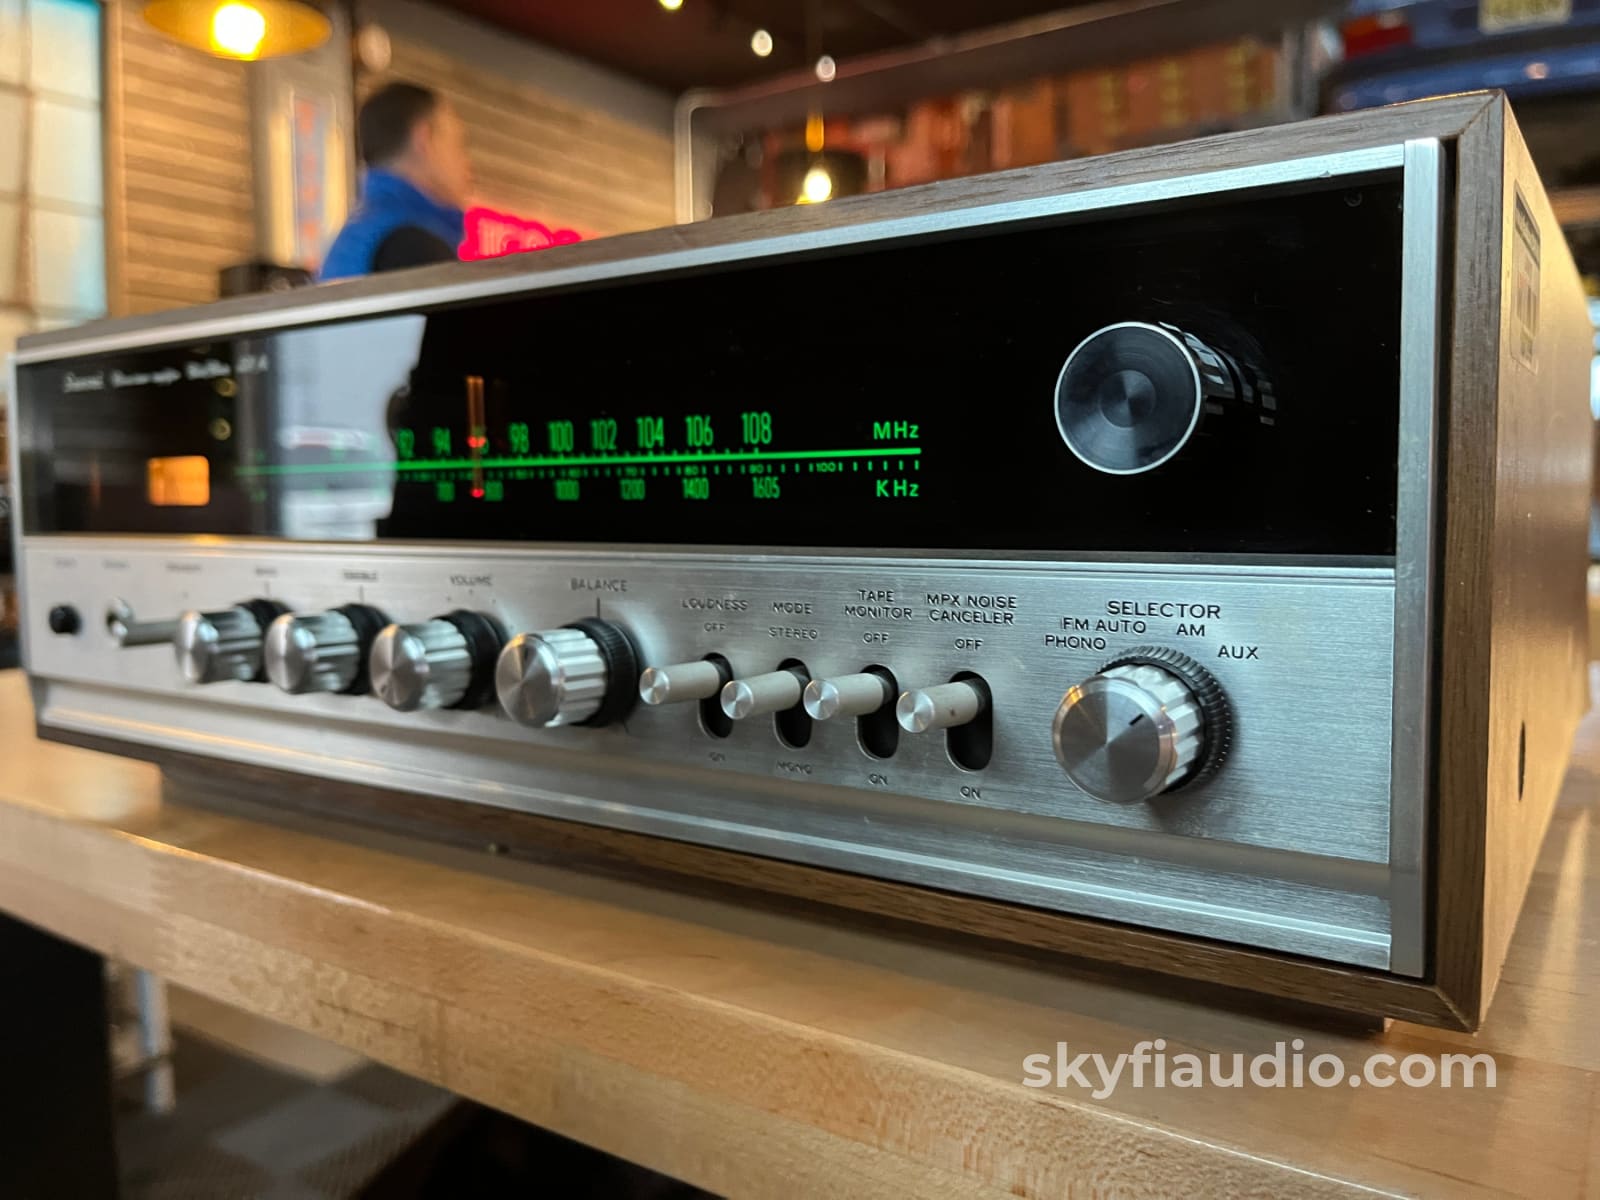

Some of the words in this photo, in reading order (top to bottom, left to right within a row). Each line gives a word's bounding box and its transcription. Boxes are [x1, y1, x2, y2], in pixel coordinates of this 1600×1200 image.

[509, 422, 529, 453] 98
[547, 420, 574, 451] 100
[590, 417, 617, 449] 102
[636, 416, 665, 448] 104
[685, 415, 714, 447] 106
[741, 411, 772, 444] 108
[873, 421, 920, 439] MHz
[752, 476, 780, 498] 1605
[571, 577, 628, 592] BALANCE
[858, 589, 894, 602] TAPE
[927, 594, 959, 607] MPX
[967, 595, 1017, 609] NOISE
[682, 598, 749, 611] LOUDNESS
[773, 602, 812, 614] MODE
[1107, 600, 1221, 619] SELECTOR
[845, 605, 912, 618] MONITOR
[929, 609, 1014, 625] CANCELER
[704, 623, 725, 632] OFF
[1062, 617, 1089, 630] FM
[1096, 619, 1146, 634] AUTO
[1176, 623, 1205, 636] AM
[769, 627, 818, 640] STEREO
[863, 632, 889, 644] OFF
[954, 638, 982, 650] OFF
[1045, 635, 1106, 650] PHONO
[1218, 645, 1259, 660] AUX
[777, 761, 812, 775] MONO
[869, 773, 888, 785] ON
[960, 785, 980, 798] ON
